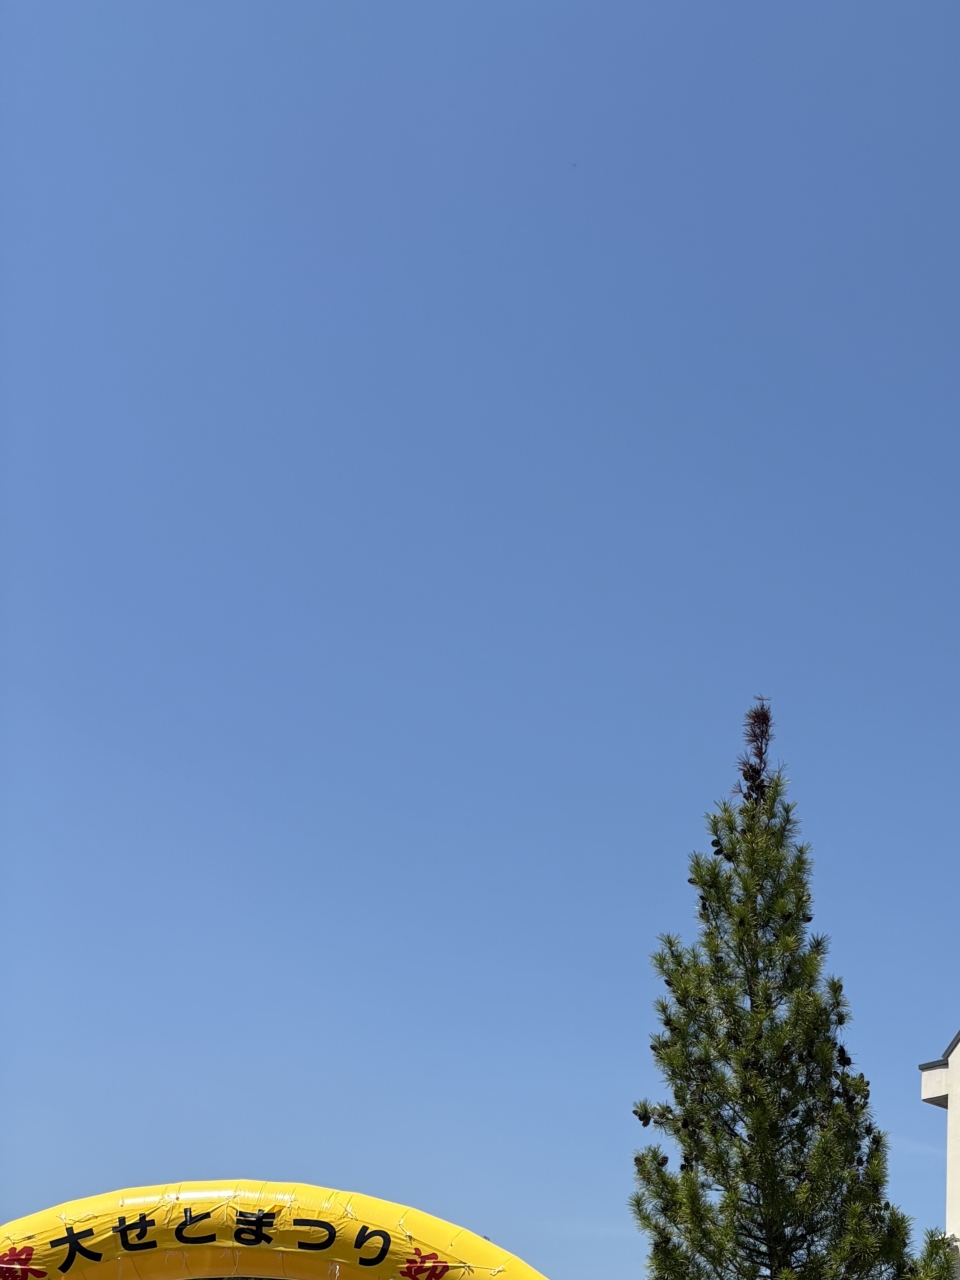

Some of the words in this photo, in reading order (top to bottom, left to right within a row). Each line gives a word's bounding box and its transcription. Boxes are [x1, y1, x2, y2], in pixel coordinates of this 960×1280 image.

[50, 1207, 391, 1274] 大せとまつり
